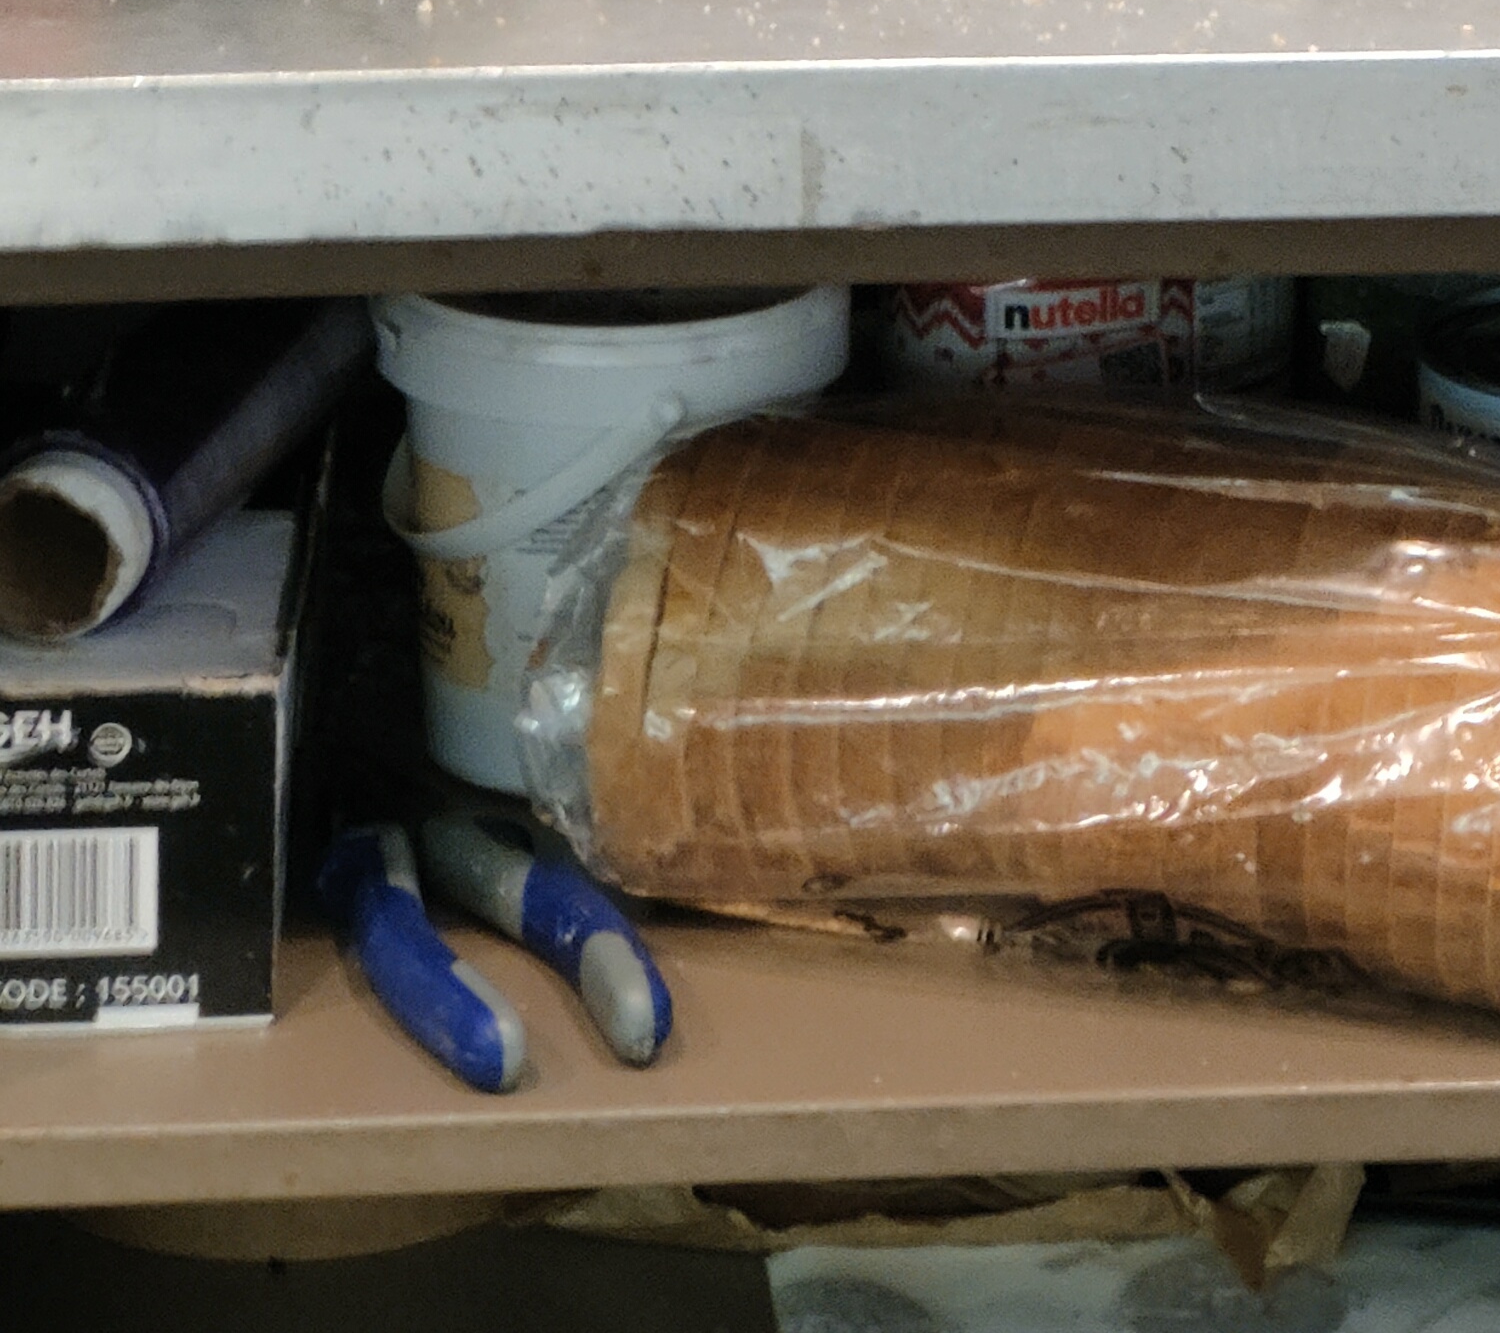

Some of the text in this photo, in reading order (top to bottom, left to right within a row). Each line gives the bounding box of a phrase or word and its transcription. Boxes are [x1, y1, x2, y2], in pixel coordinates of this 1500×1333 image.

[1003, 289, 1147, 332] nutella
[0, 976, 67, 1011] ODE
[96, 973, 200, 1005] 155001
